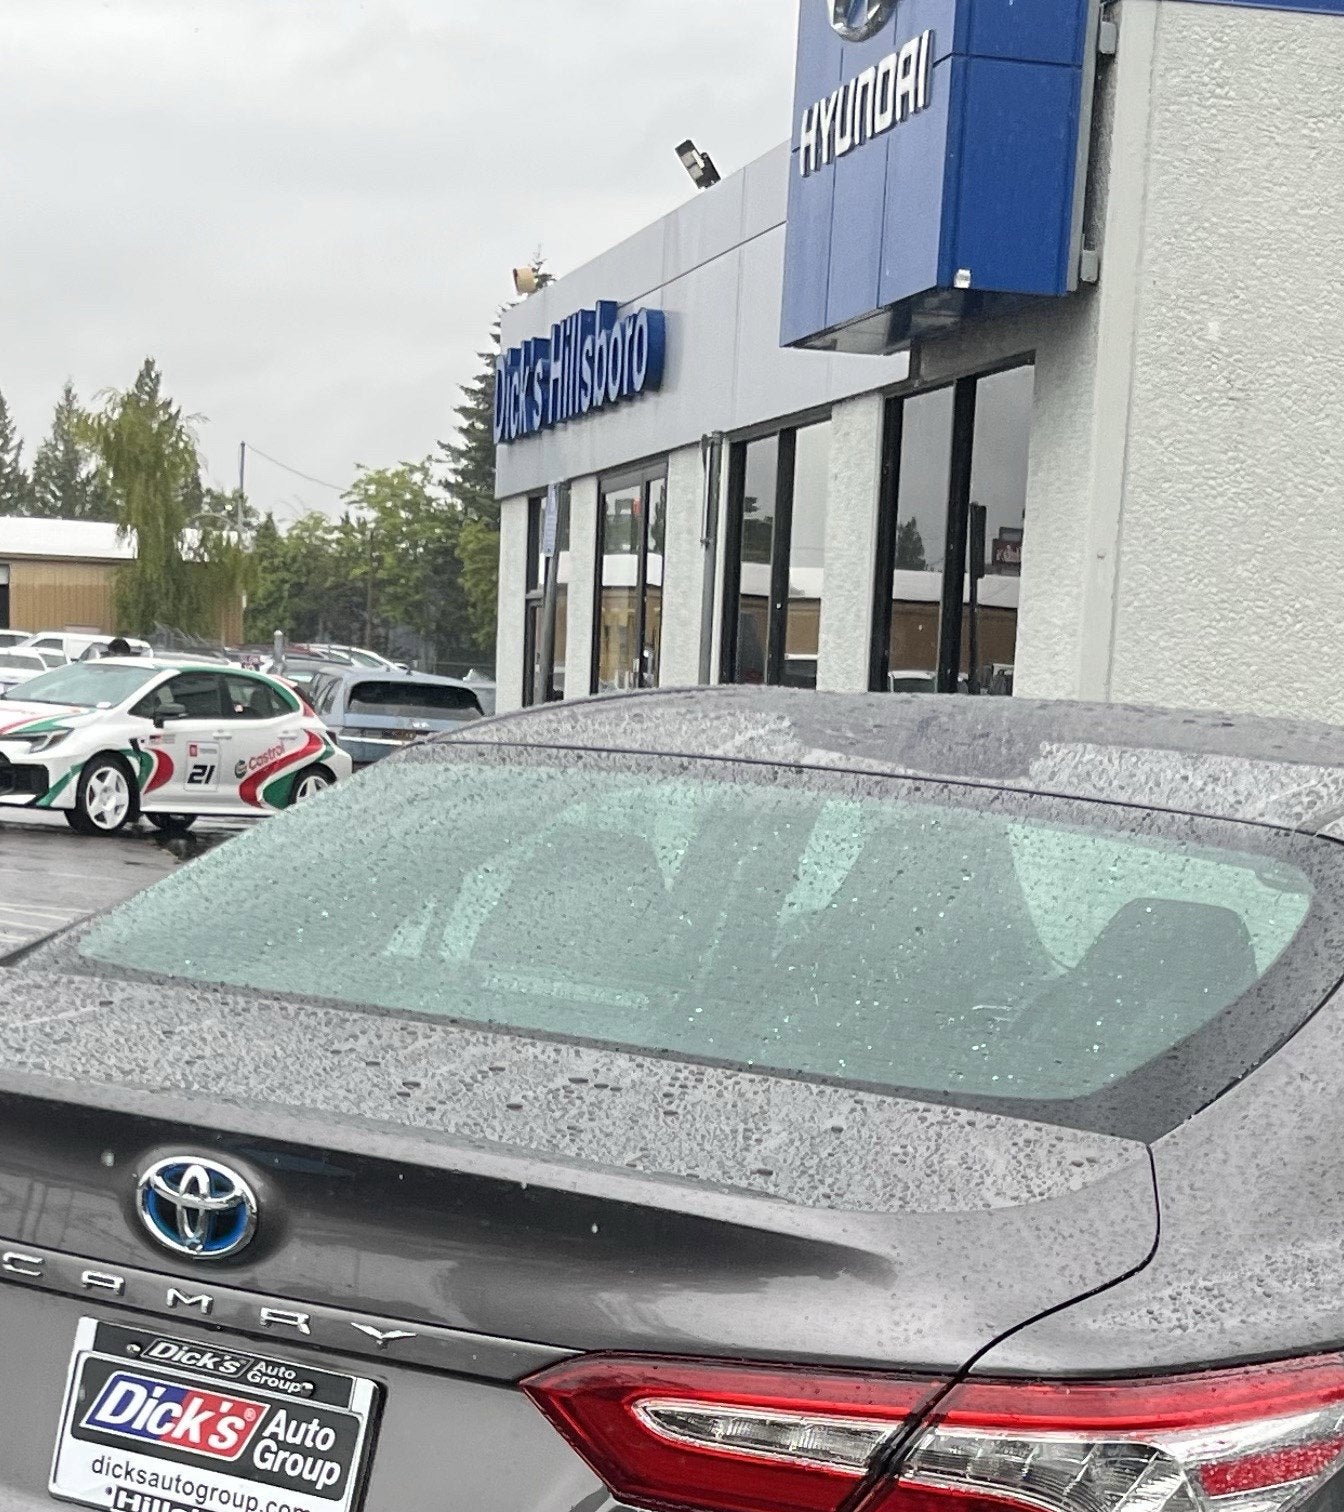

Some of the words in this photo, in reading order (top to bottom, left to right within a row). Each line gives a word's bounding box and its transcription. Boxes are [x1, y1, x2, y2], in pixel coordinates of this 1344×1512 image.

[800, 29, 931, 176] HYUNDAI
[494, 337, 543, 444] Dick's
[549, 301, 652, 424] Hillsboro
[187, 765, 216, 784] 21
[248, 741, 286, 770] Castrol
[2, 1251, 418, 1350] CAMRY
[148, 1341, 241, 1374] Dick's
[255, 1361, 297, 1380] Auto
[246, 1371, 302, 1394] Group
[94, 1380, 246, 1451] Dick's
[261, 1408, 336, 1451] Auto
[252, 1438, 342, 1490] Group
